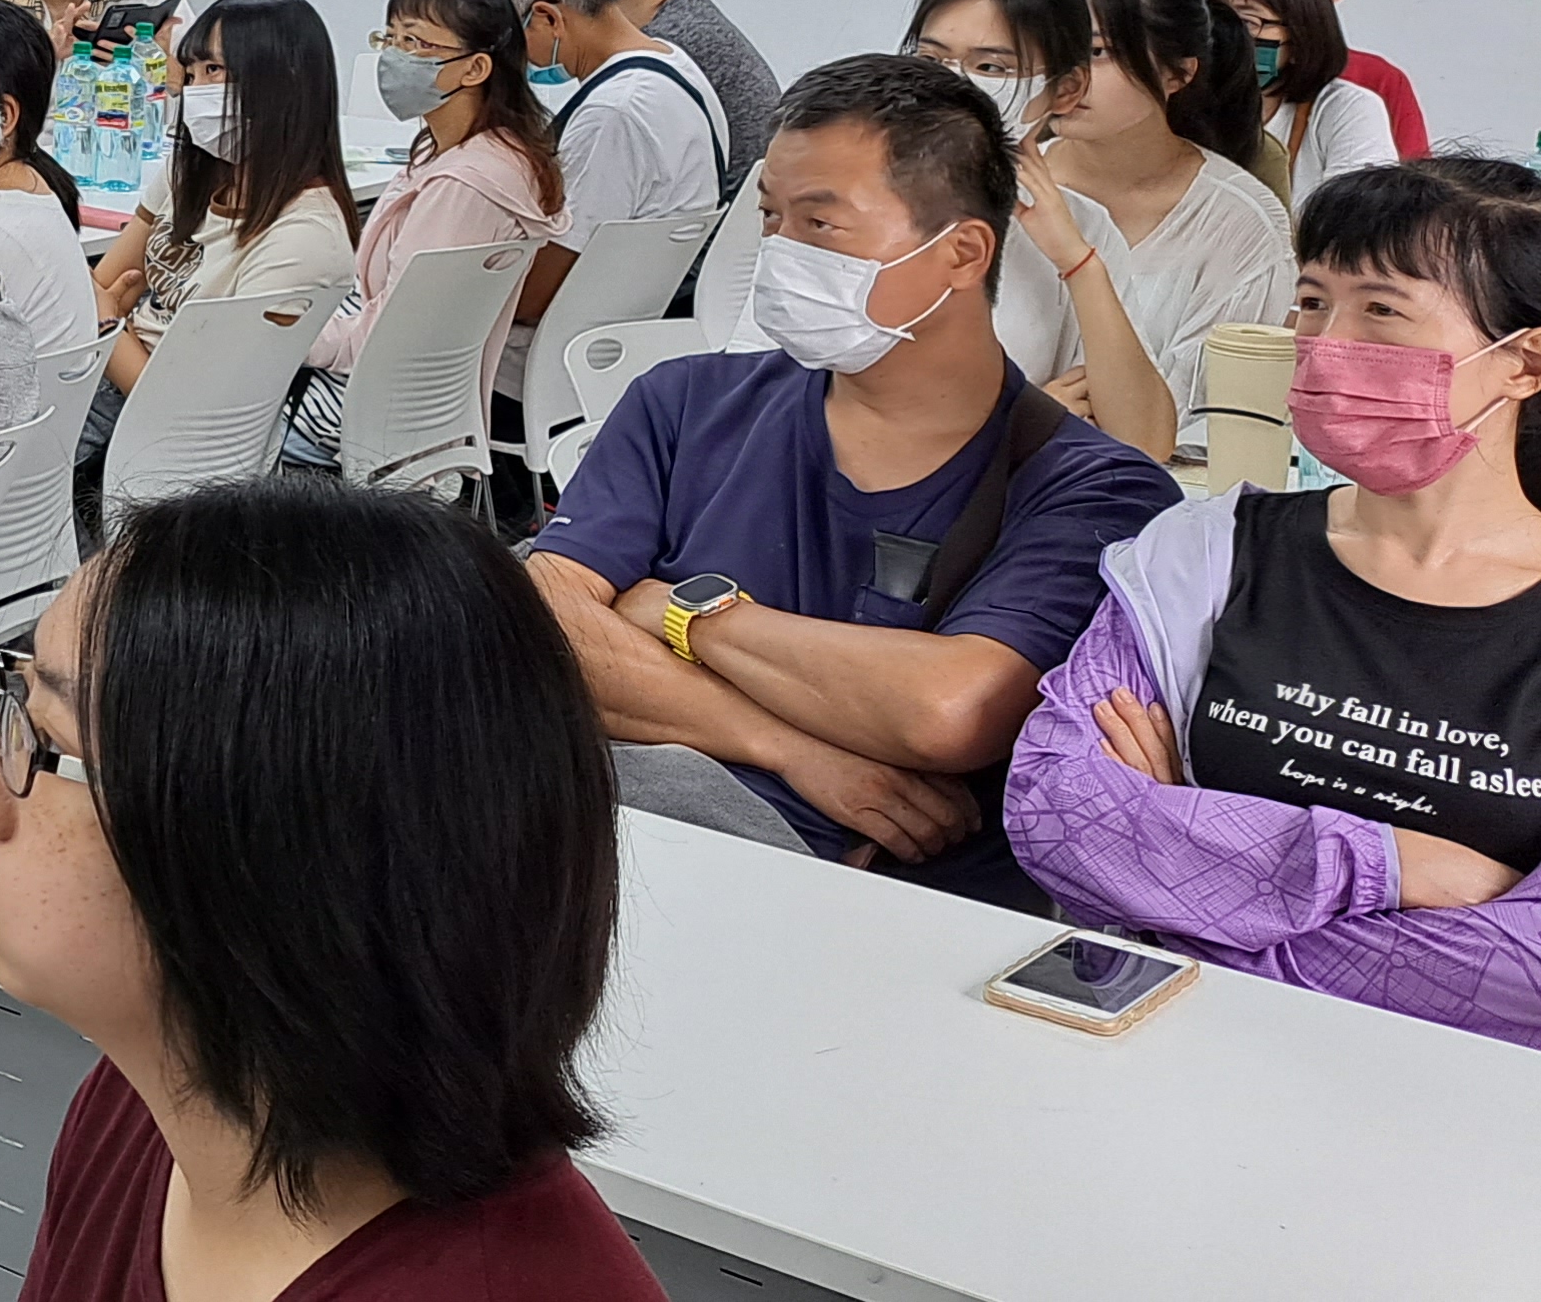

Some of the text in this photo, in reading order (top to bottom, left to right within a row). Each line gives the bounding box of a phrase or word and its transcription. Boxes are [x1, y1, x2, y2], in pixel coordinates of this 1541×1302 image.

[1208, 698, 1269, 733] when
[1271, 719, 1335, 749] you
[1342, 739, 1397, 768] can
[1404, 748, 1461, 784] fall
[1275, 683, 1509, 757] why fall in love,
